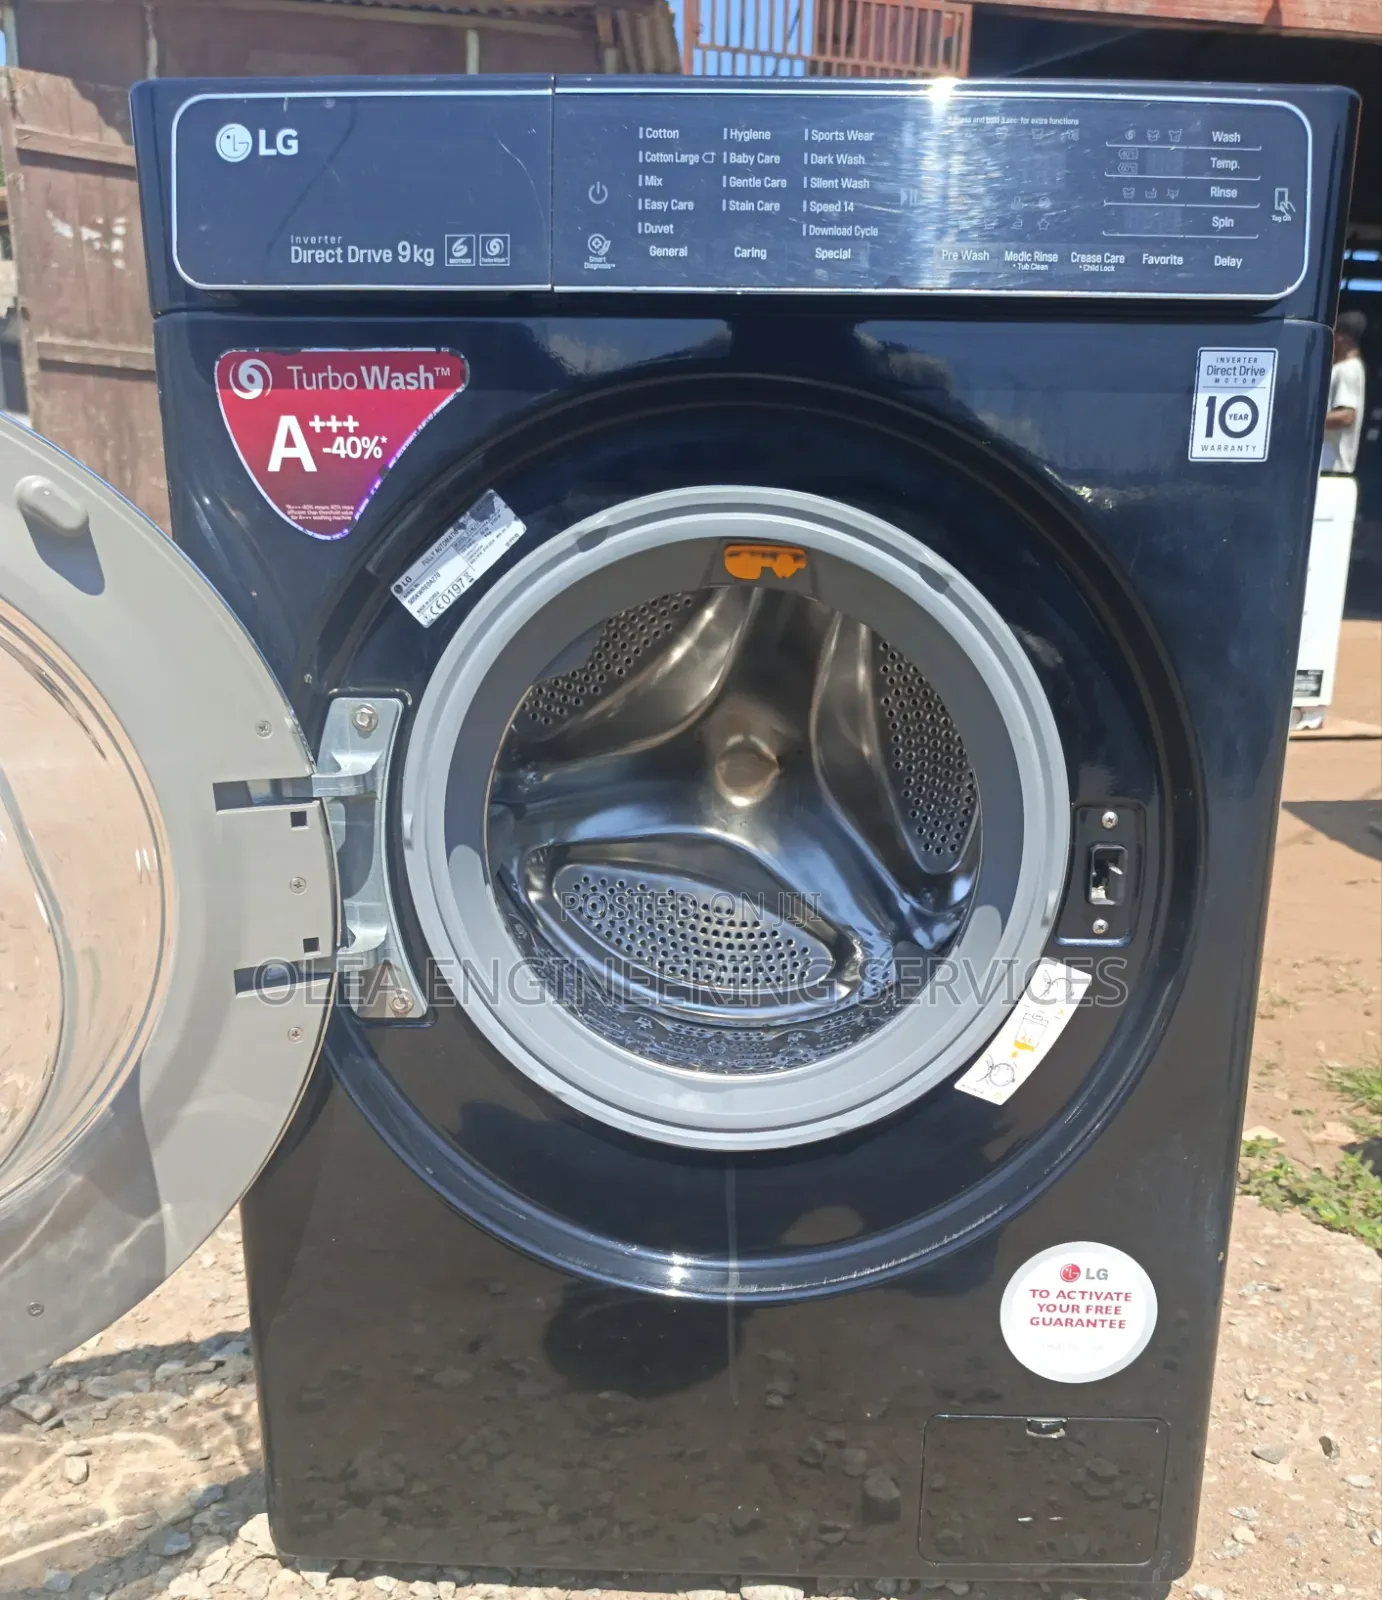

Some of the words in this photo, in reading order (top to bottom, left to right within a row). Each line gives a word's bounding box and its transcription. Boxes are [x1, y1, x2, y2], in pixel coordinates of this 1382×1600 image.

[646, 128, 680, 139] Cotton
[730, 128, 771, 142] Hygiene
[811, 130, 844, 142] Sports
[847, 130, 874, 141] Wear
[1212, 132, 1240, 143] Wash
[258, 128, 298, 156] LG
[645, 152, 674, 163] Cotton
[676, 152, 700, 165] Large
[730, 152, 754, 165] Baby
[757, 153, 780, 164] Care
[810, 154, 834, 165] Dark
[836, 154, 865, 165] Wash
[1210, 158, 1240, 170] Temp.
[644, 176, 663, 187] Mix
[729, 176, 762, 188] Gentle
[764, 177, 787, 188] Care
[810, 178, 839, 188] Silent
[841, 178, 870, 189] Wash
[1210, 187, 1238, 198] Rinse
[644, 199, 668, 212] Easy
[671, 199, 694, 210] Care
[728, 200, 755, 211] Stain
[757, 200, 780, 211] Care
[809, 201, 841, 214] Speed
[844, 202, 854, 212] 14
[644, 223, 674, 234] Duvet
[1212, 216, 1234, 229] Spin
[809, 225, 852, 236] Download
[854, 225, 878, 238] Cycle
[291, 235, 343, 244] Inverter
[291, 246, 343, 263] Direct
[348, 246, 392, 263] Drive
[649, 246, 688, 257] General
[734, 247, 767, 260] Caring
[815, 248, 852, 260] Special
[942, 250, 959, 261] Pre
[961, 250, 990, 261] Wash
[1004, 251, 1032, 262] Medic
[1034, 251, 1058, 263] Rinse
[1071, 252, 1101, 263] Crease
[1104, 253, 1125, 264] Care
[1142, 254, 1184, 265] Favorite
[1214, 256, 1242, 268] Delay
[1207, 365, 1236, 376] Direct
[1239, 366, 1265, 376] Drive
[1205, 395, 1259, 438] 10
[422, 550, 436, 566] FULLY
[401, 576, 412, 586] LG
[1085, 1268, 1108, 1280] LG
[1030, 1289, 1050, 1298] TO
[1056, 1290, 1132, 1302] ACTIVATE
[1038, 1303, 1080, 1314] YOUR
[1085, 1305, 1122, 1315] FREE
[1030, 1317, 1126, 1329] GUARANTEE
